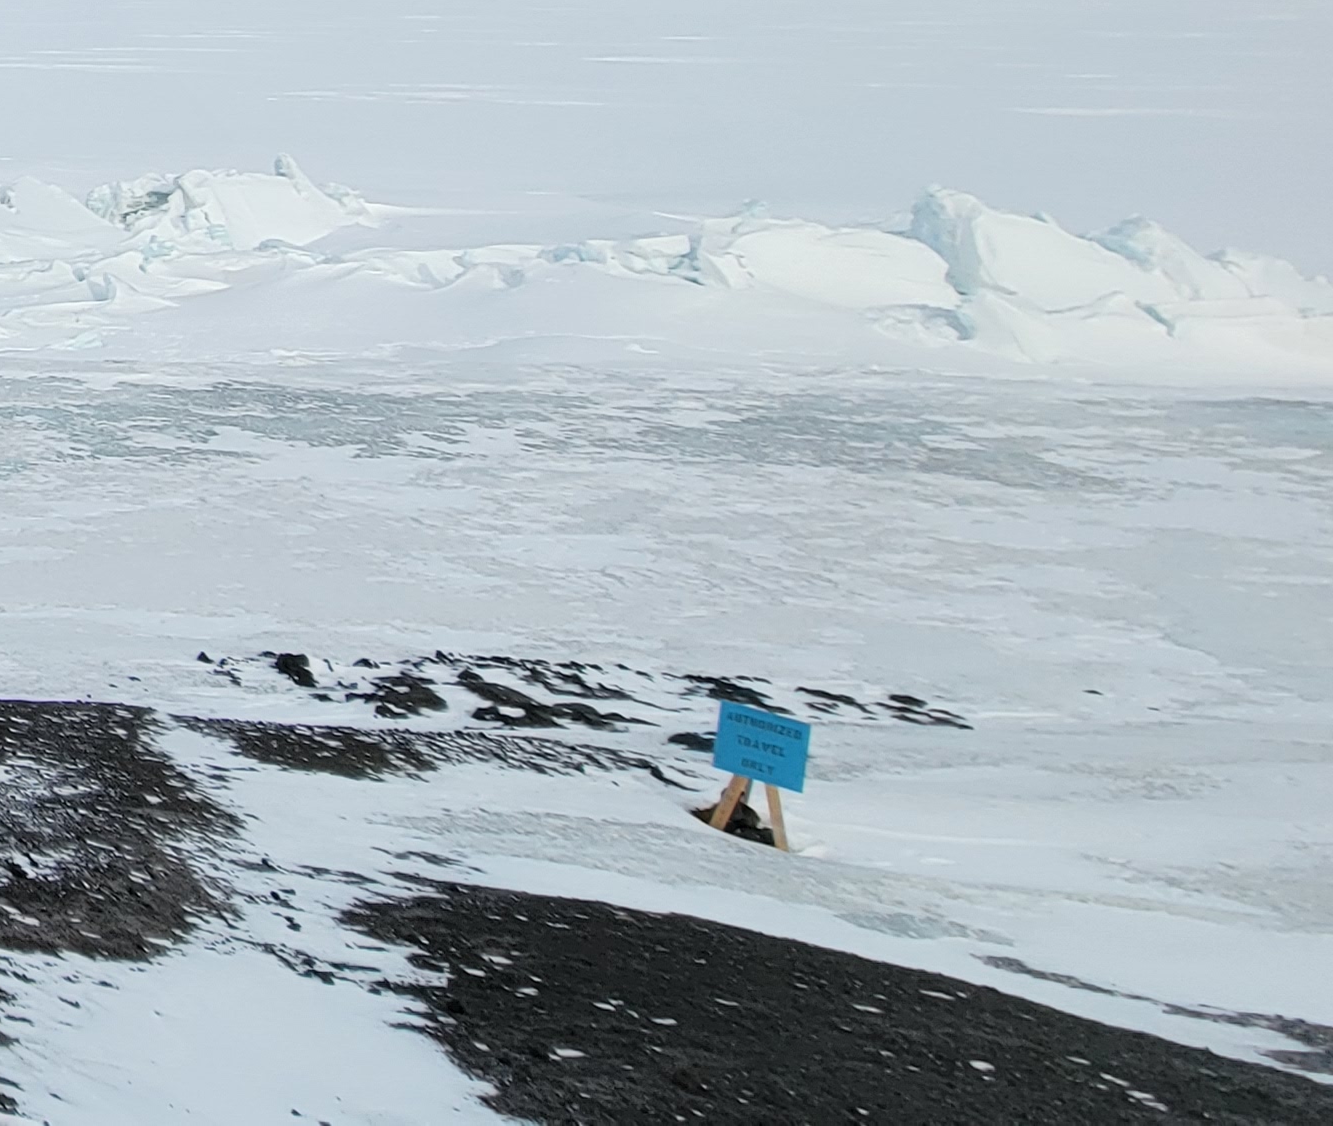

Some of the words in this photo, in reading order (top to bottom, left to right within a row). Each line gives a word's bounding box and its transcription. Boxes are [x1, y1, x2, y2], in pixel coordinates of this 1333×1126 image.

[727, 712, 802, 740] AUTHORIZED
[737, 735, 785, 757] TRAVEL
[741, 758, 775, 775] ONLY
